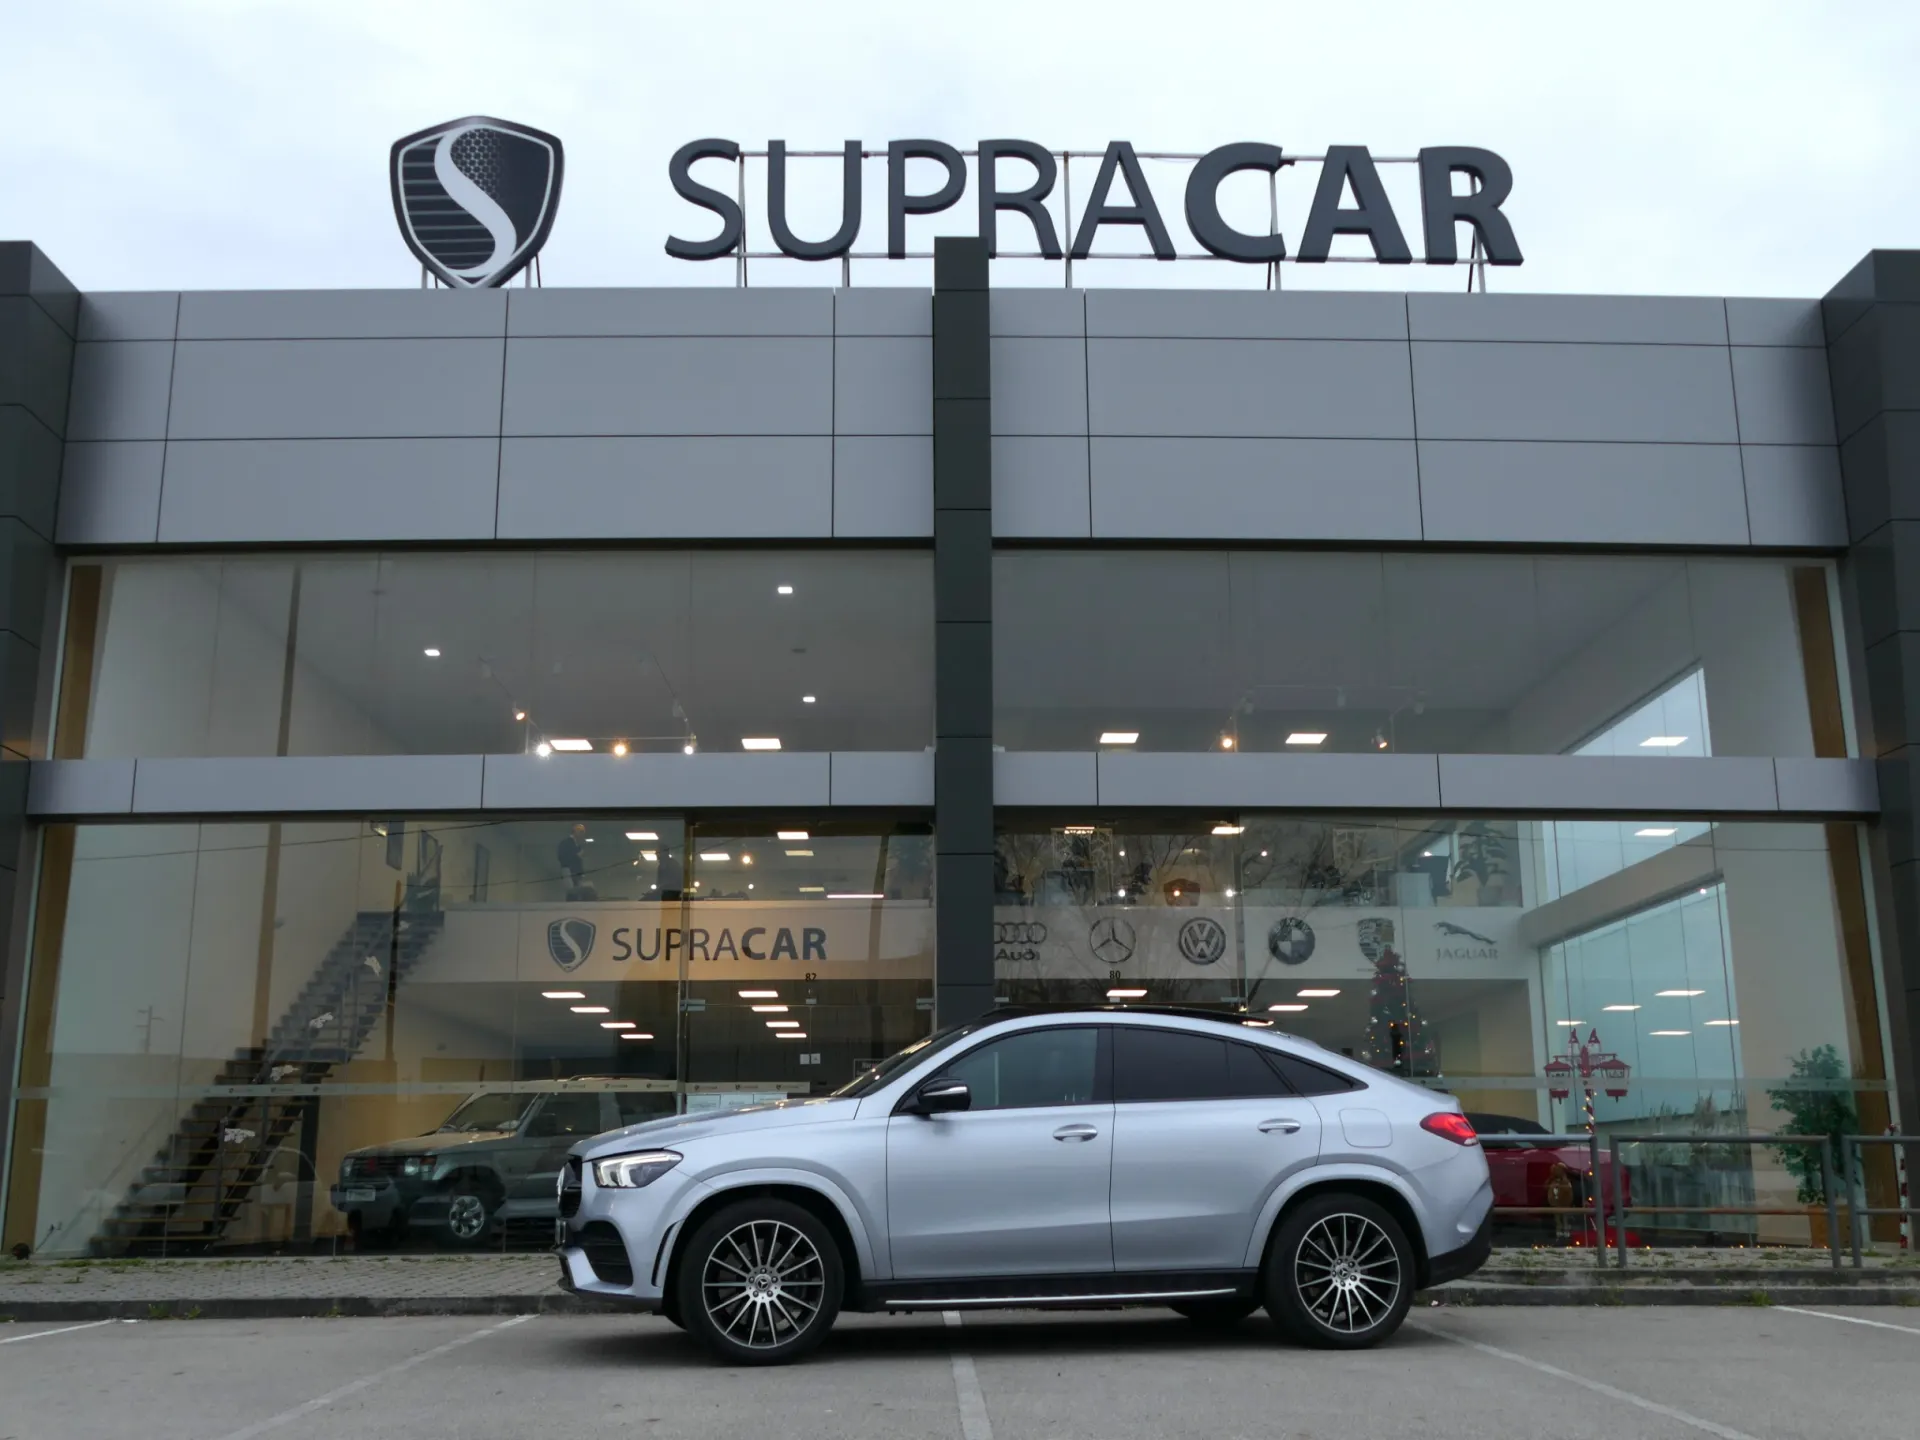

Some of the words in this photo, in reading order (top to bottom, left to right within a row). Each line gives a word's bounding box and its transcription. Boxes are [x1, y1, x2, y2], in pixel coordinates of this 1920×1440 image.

[664, 138, 1525, 265] SUPRACAR
[612, 927, 828, 961] SUPRACAR
[995, 948, 1041, 961] Audi
[1436, 948, 1499, 962] JAGUAR
[1109, 970, 1121, 980] 80
